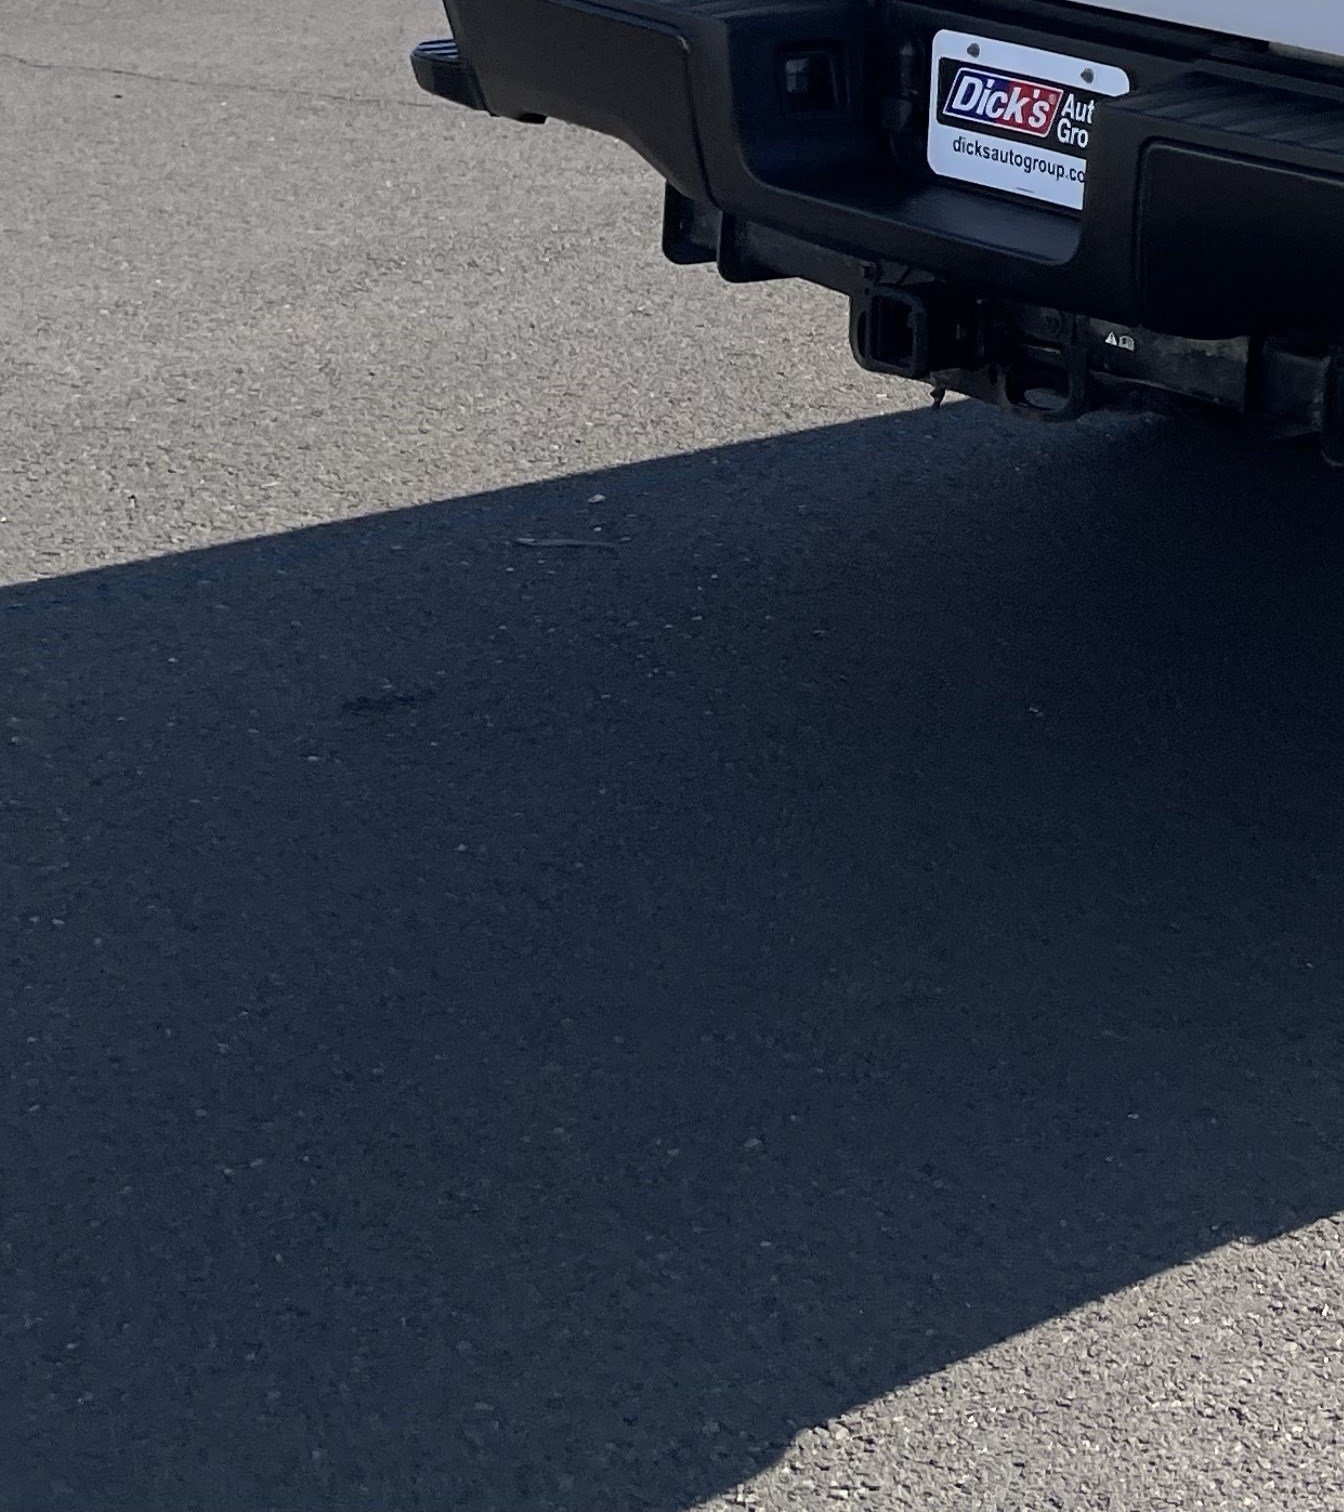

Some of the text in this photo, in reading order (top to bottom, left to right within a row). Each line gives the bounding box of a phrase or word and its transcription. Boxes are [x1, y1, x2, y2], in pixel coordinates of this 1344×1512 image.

[952, 75, 1051, 129] Dick's
[1060, 93, 1095, 124] Aut
[1057, 118, 1089, 149] Gro
[952, 136, 1086, 183] dicksautogroup.co
